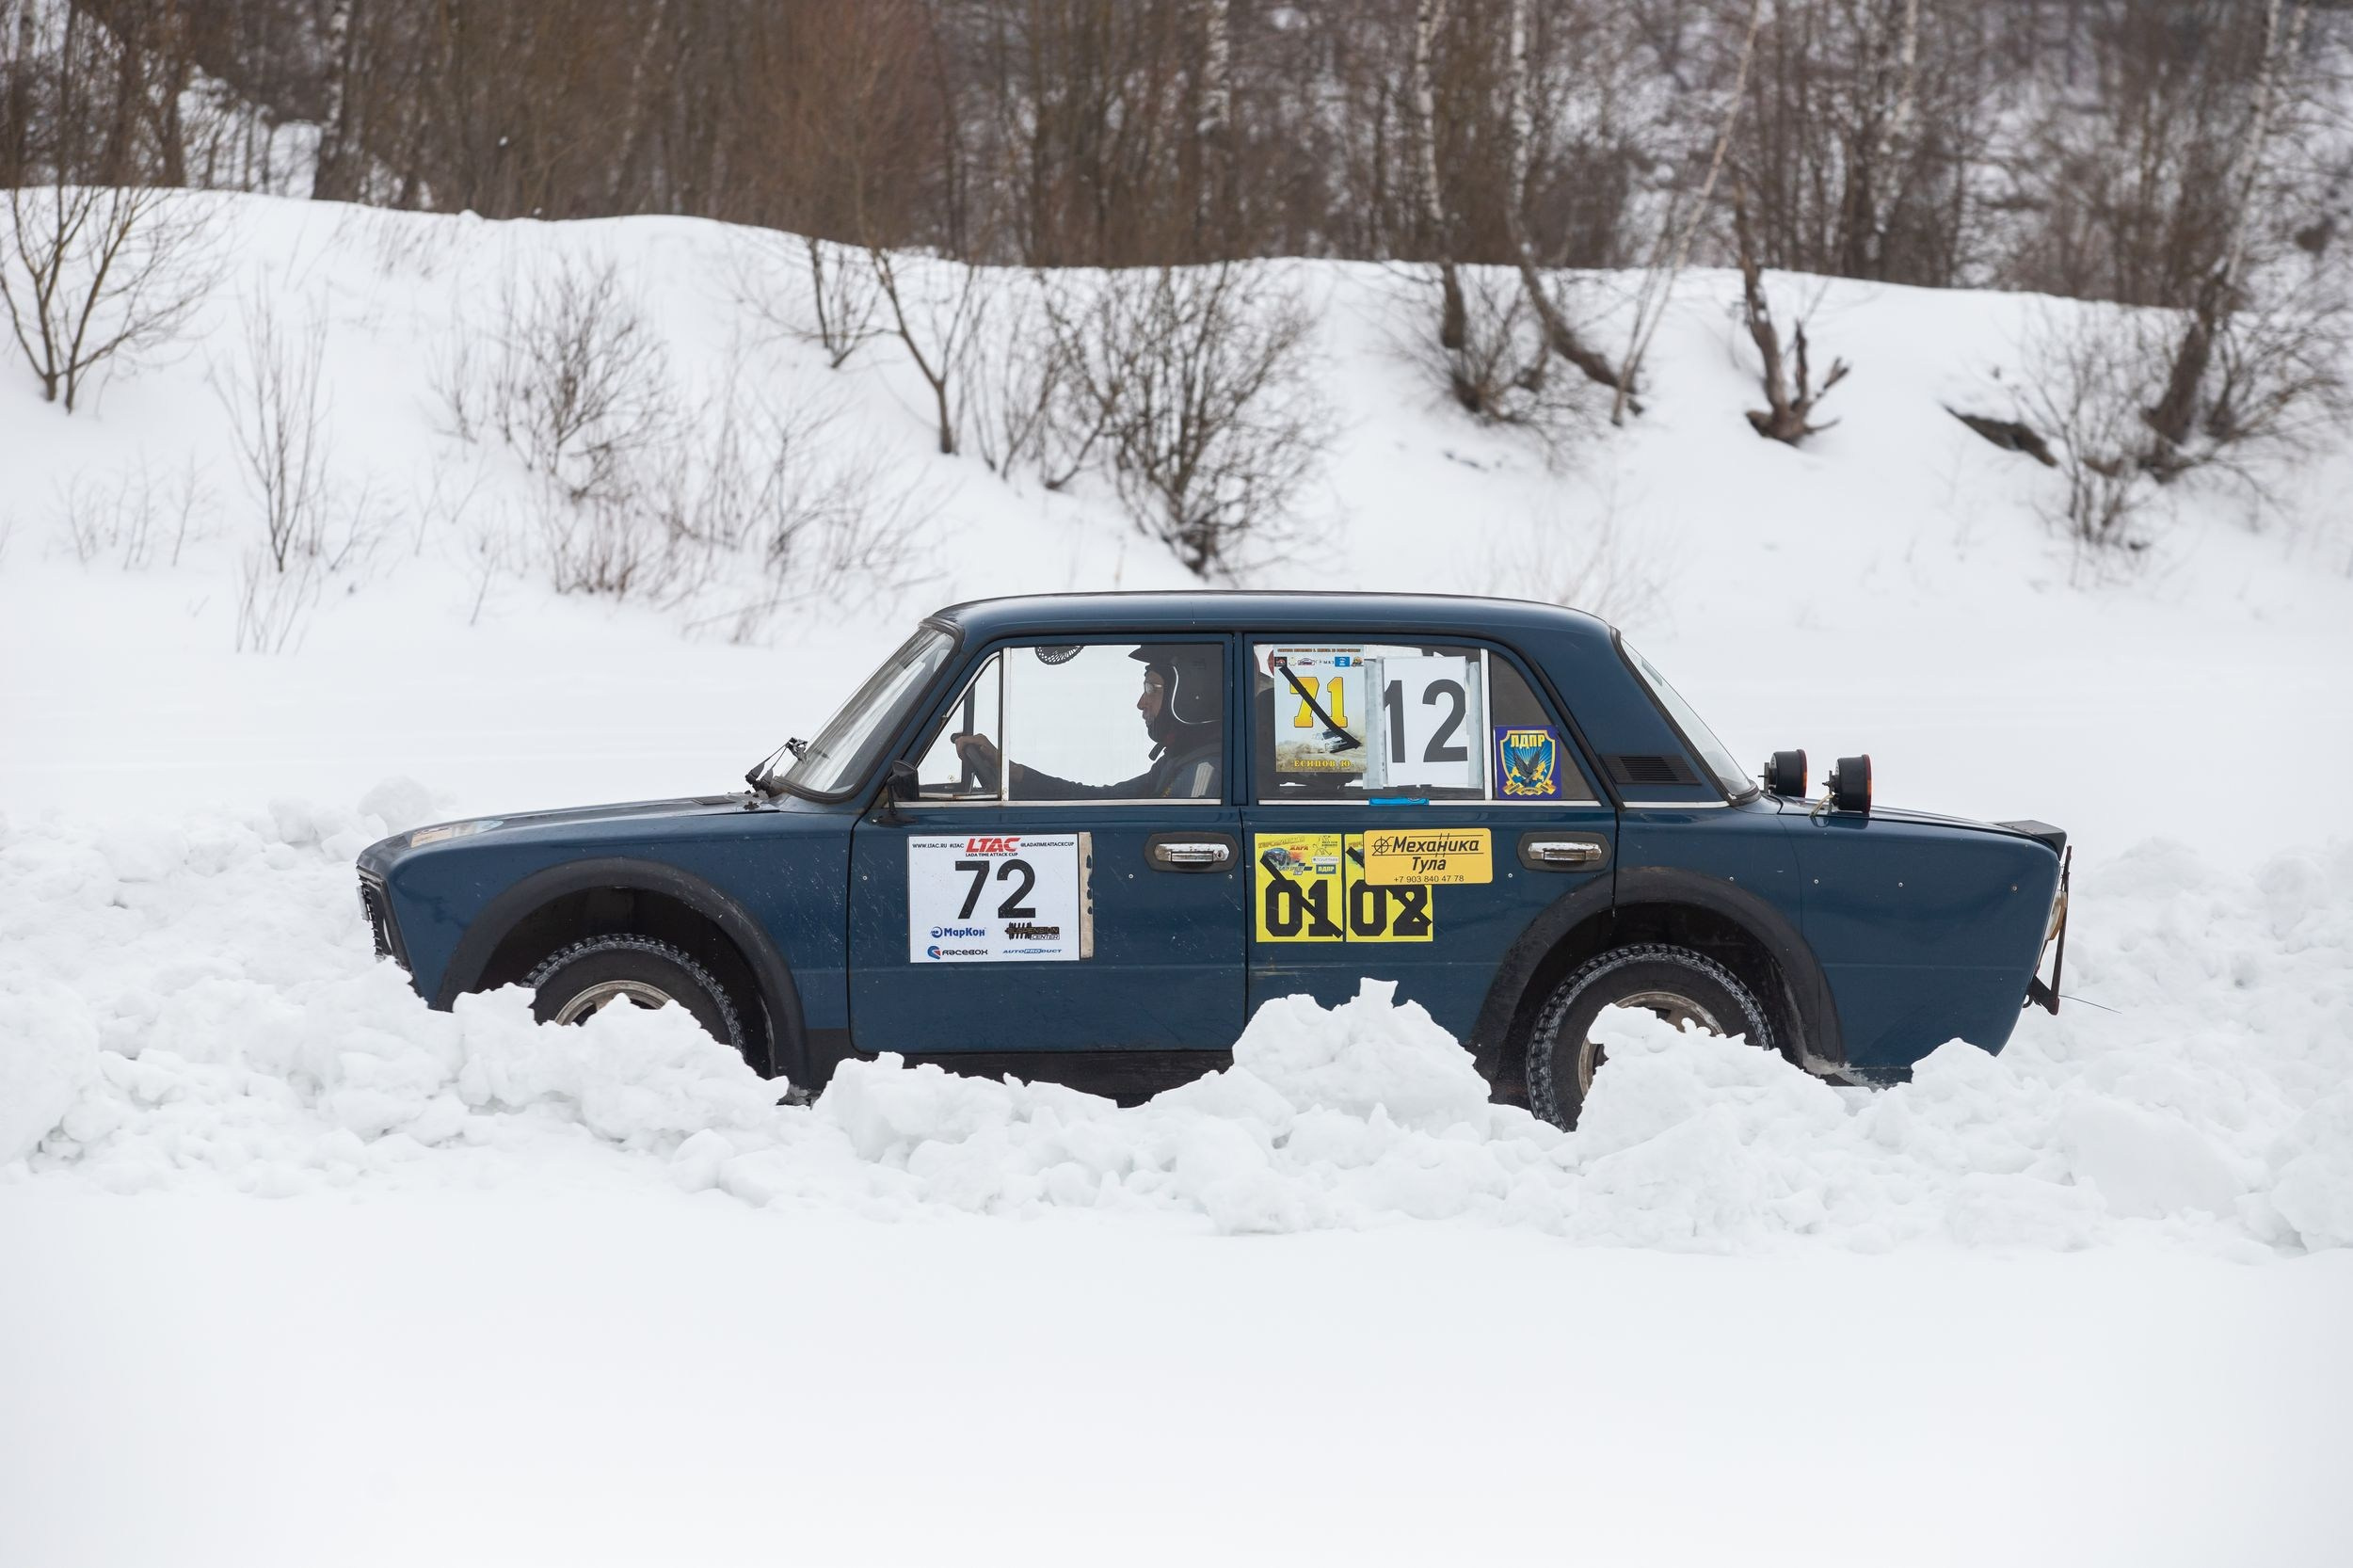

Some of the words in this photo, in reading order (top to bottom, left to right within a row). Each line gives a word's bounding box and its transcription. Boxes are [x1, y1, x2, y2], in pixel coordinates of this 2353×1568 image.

[1289, 676, 1349, 728] 71
[1385, 679, 1468, 763] 12
[1511, 734, 1545, 749] ЛДПР
[966, 838, 1020, 853] LTAC
[1392, 836, 1480, 853] Механика
[1412, 856, 1447, 874] Тула
[954, 858, 1036, 920] 72
[944, 927, 985, 938] МарКон
